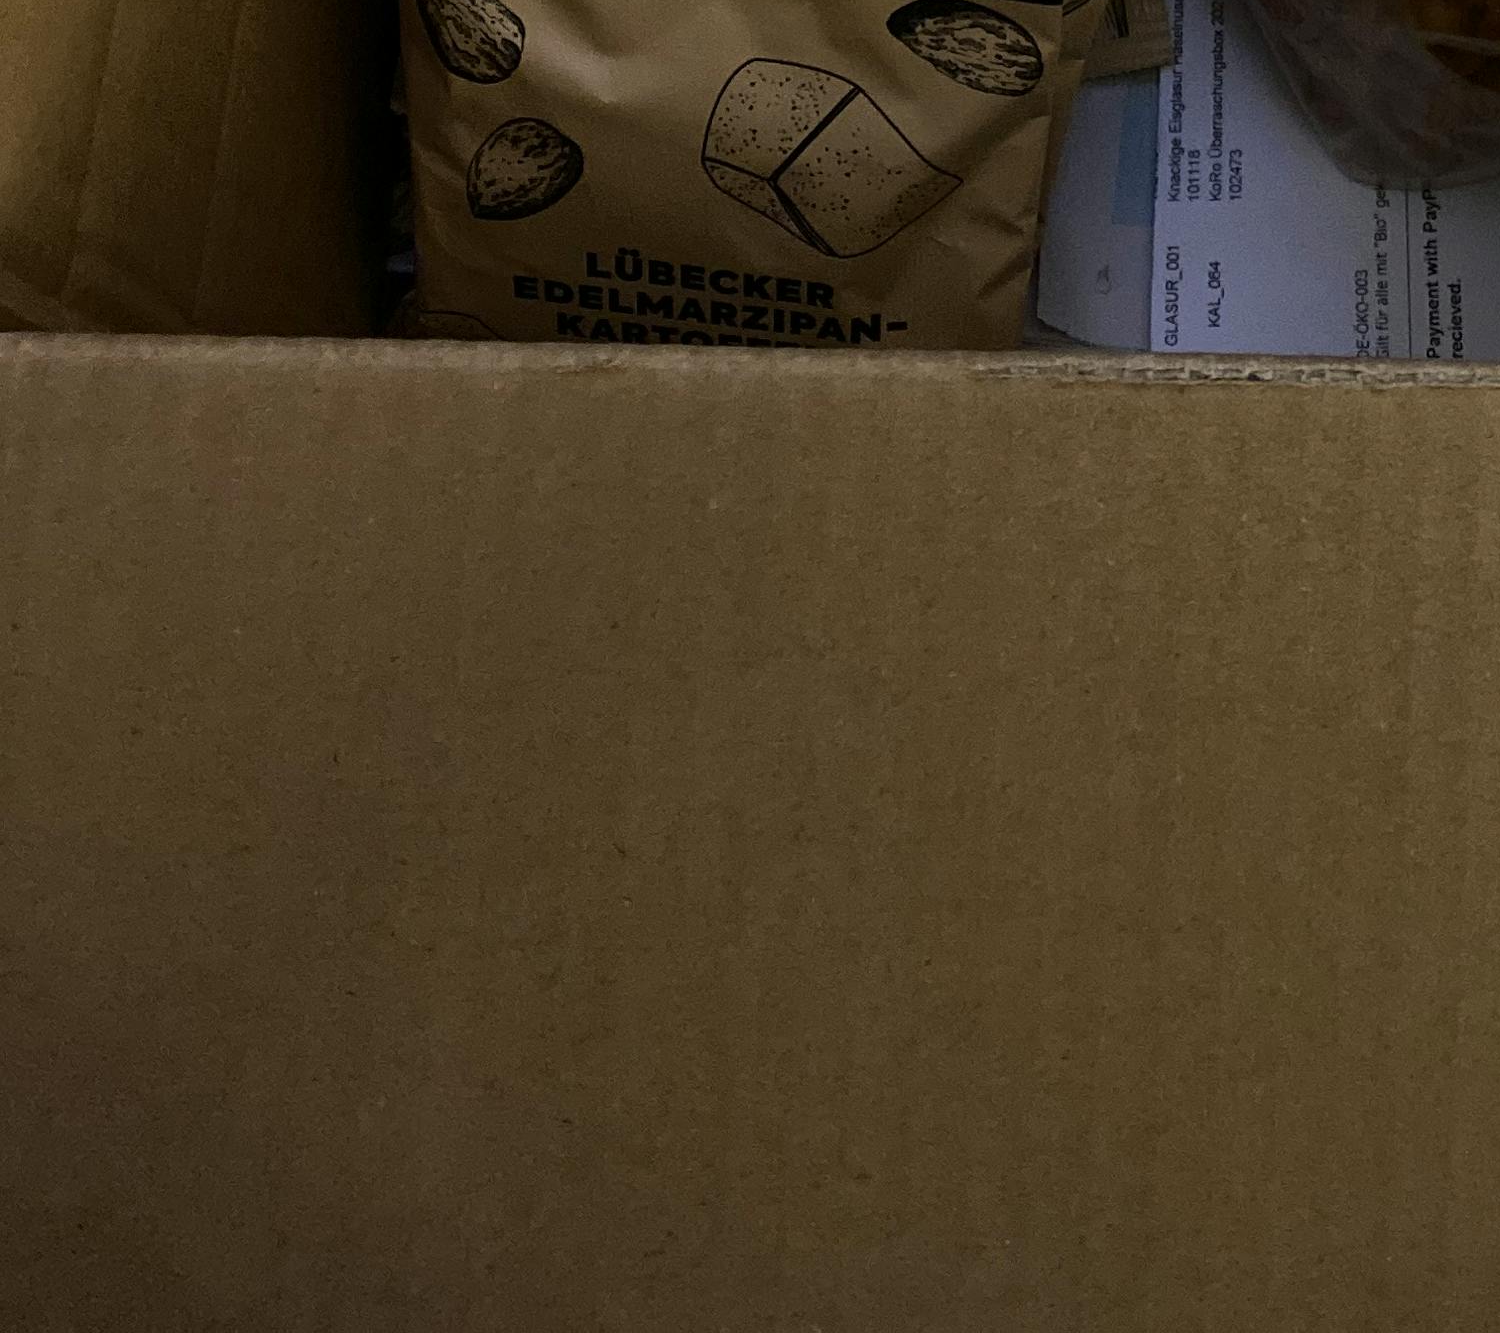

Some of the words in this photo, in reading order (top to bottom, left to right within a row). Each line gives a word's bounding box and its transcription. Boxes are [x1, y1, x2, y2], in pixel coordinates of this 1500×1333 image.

[1168, 67, 1186, 133] Eisglasur
[1208, 27, 1229, 158] Überraschungsbox
[1167, 137, 1185, 202] Knackige
[1186, 149, 1201, 201] 101118
[1208, 162, 1222, 202] KoRo
[1228, 148, 1243, 200] 102473
[1420, 187, 1438, 233] PayP
[585, 247, 835, 310] LÜBECKER
[1375, 252, 1387, 275] mit
[1423, 239, 1437, 276] with
[513, 275, 908, 344] EDELMARZIPAN-
[1164, 245, 1183, 347] GLASUR_001
[1207, 261, 1224, 328] KAL_064
[1374, 309, 1389, 331] für
[1375, 280, 1387, 306] alle
[1426, 281, 1442, 359] Payment
[1447, 279, 1464, 359] recieved.
